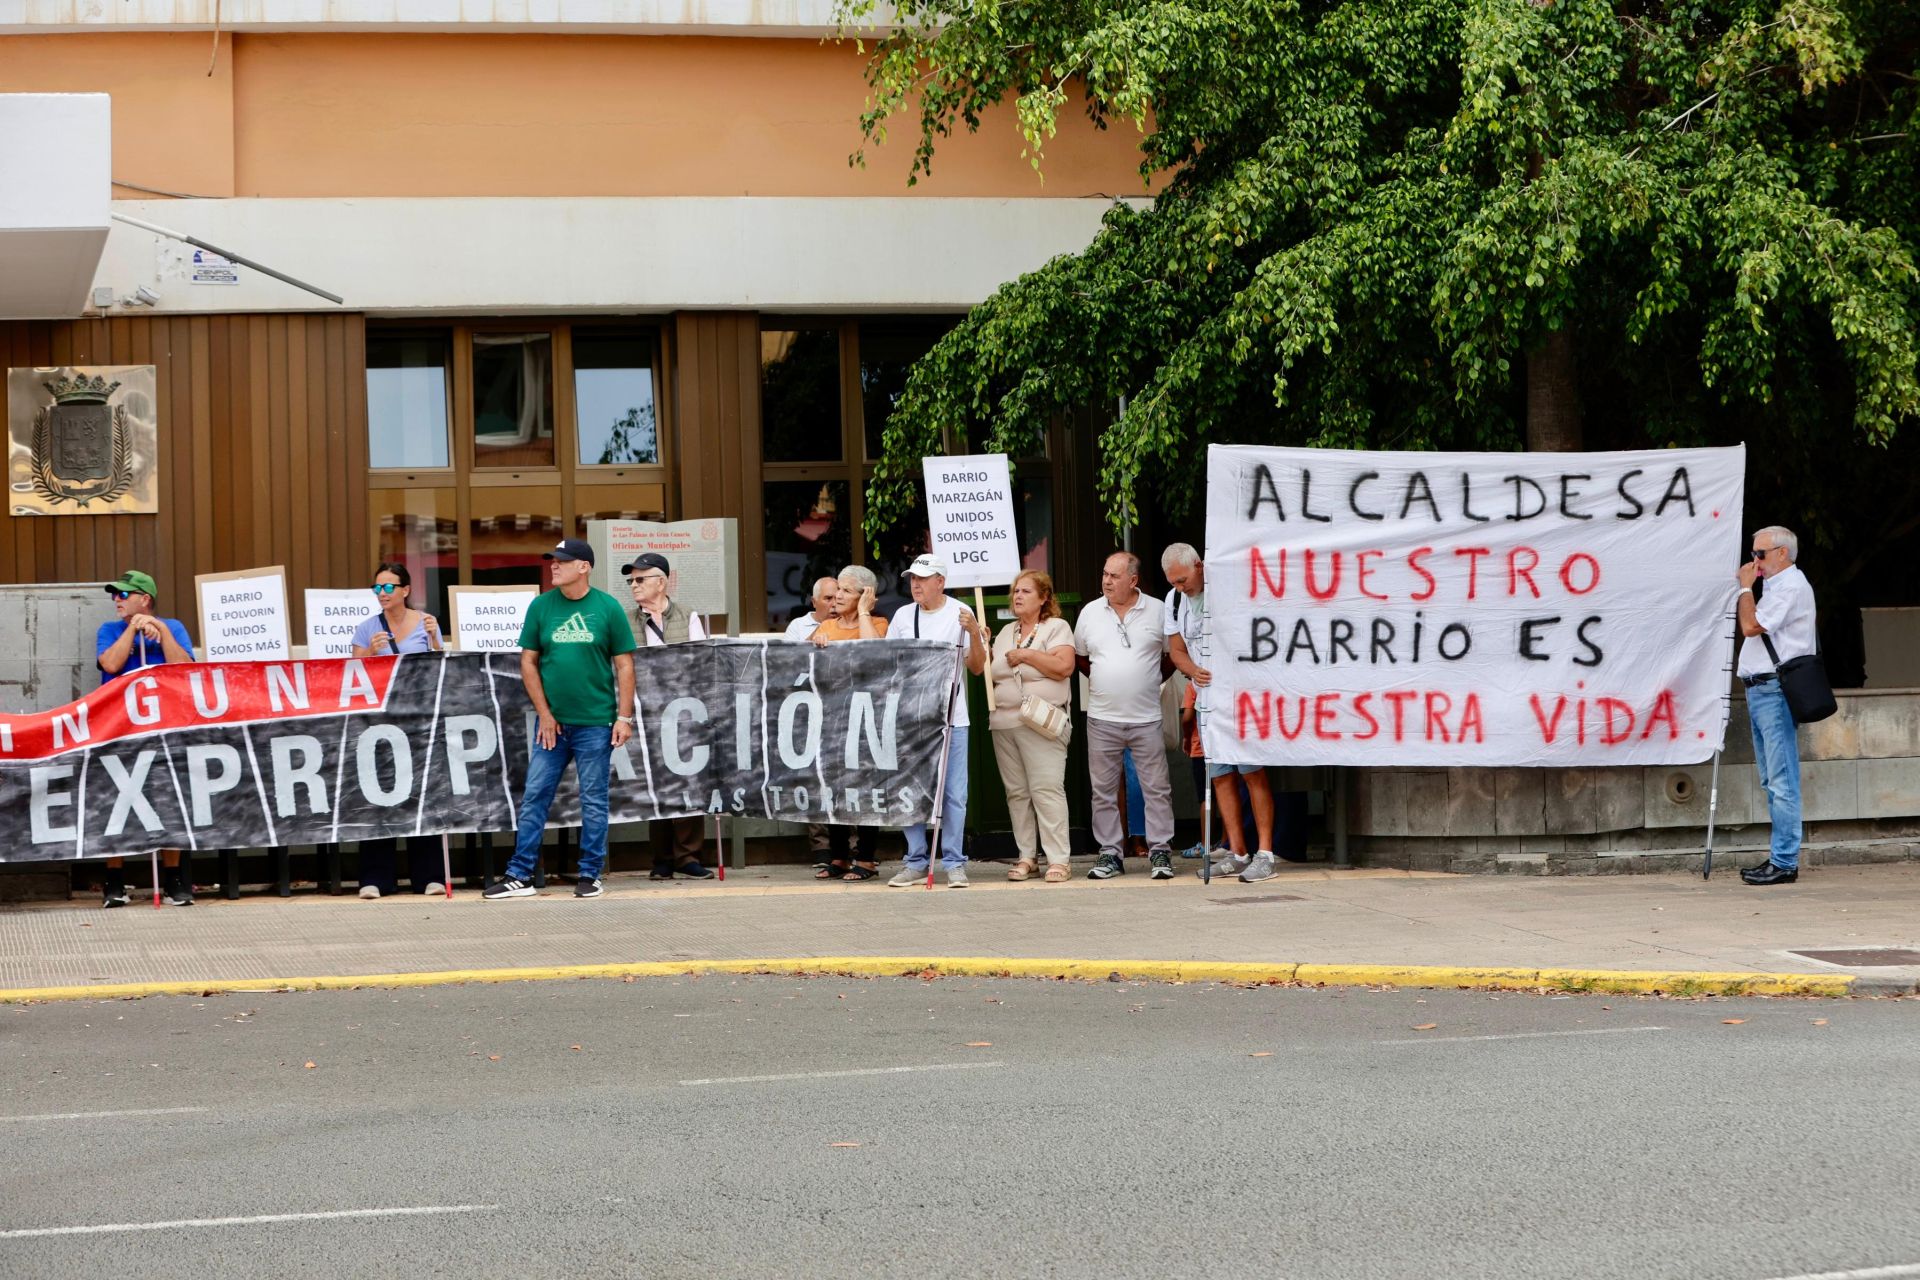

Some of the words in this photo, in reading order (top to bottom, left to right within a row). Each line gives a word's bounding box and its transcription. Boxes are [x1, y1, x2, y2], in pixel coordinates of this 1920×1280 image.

[942, 471, 988, 484] BARRIO
[932, 489, 1003, 504] MARZAGÁN
[1248, 463, 1721, 523] ALCALDESA.
[946, 511, 994, 523] UNIDOS
[937, 531, 979, 543] SOMOS
[981, 528, 1007, 540] MÁS
[612, 542, 643, 550] Oficinas
[647, 541, 691, 551] Municipales
[953, 550, 989, 564] LPGC
[1248, 545, 1602, 600] NUESTRO
[220, 591, 263, 604] BARRIO
[211, 613, 222, 621] EL
[224, 607, 275, 620] POLVORIN
[324, 606, 370, 616] BARRIO
[475, 606, 516, 615] BARRIO
[222, 624, 267, 637] UNIDOS
[314, 625, 327, 635] EL
[330, 625, 358, 635] CAR
[461, 623, 491, 632] LOMO
[210, 643, 252, 656] SOMOS
[256, 639, 281, 652] MÁS
[477, 638, 520, 648] UNIDOS
[1519, 616, 1604, 667] ES
[1237, 690, 1485, 743] NUESTRA
[30, 673, 899, 844] EXPROPCIÓN
[682, 787, 746, 814] LAS
[768, 785, 915, 814] TORRES
